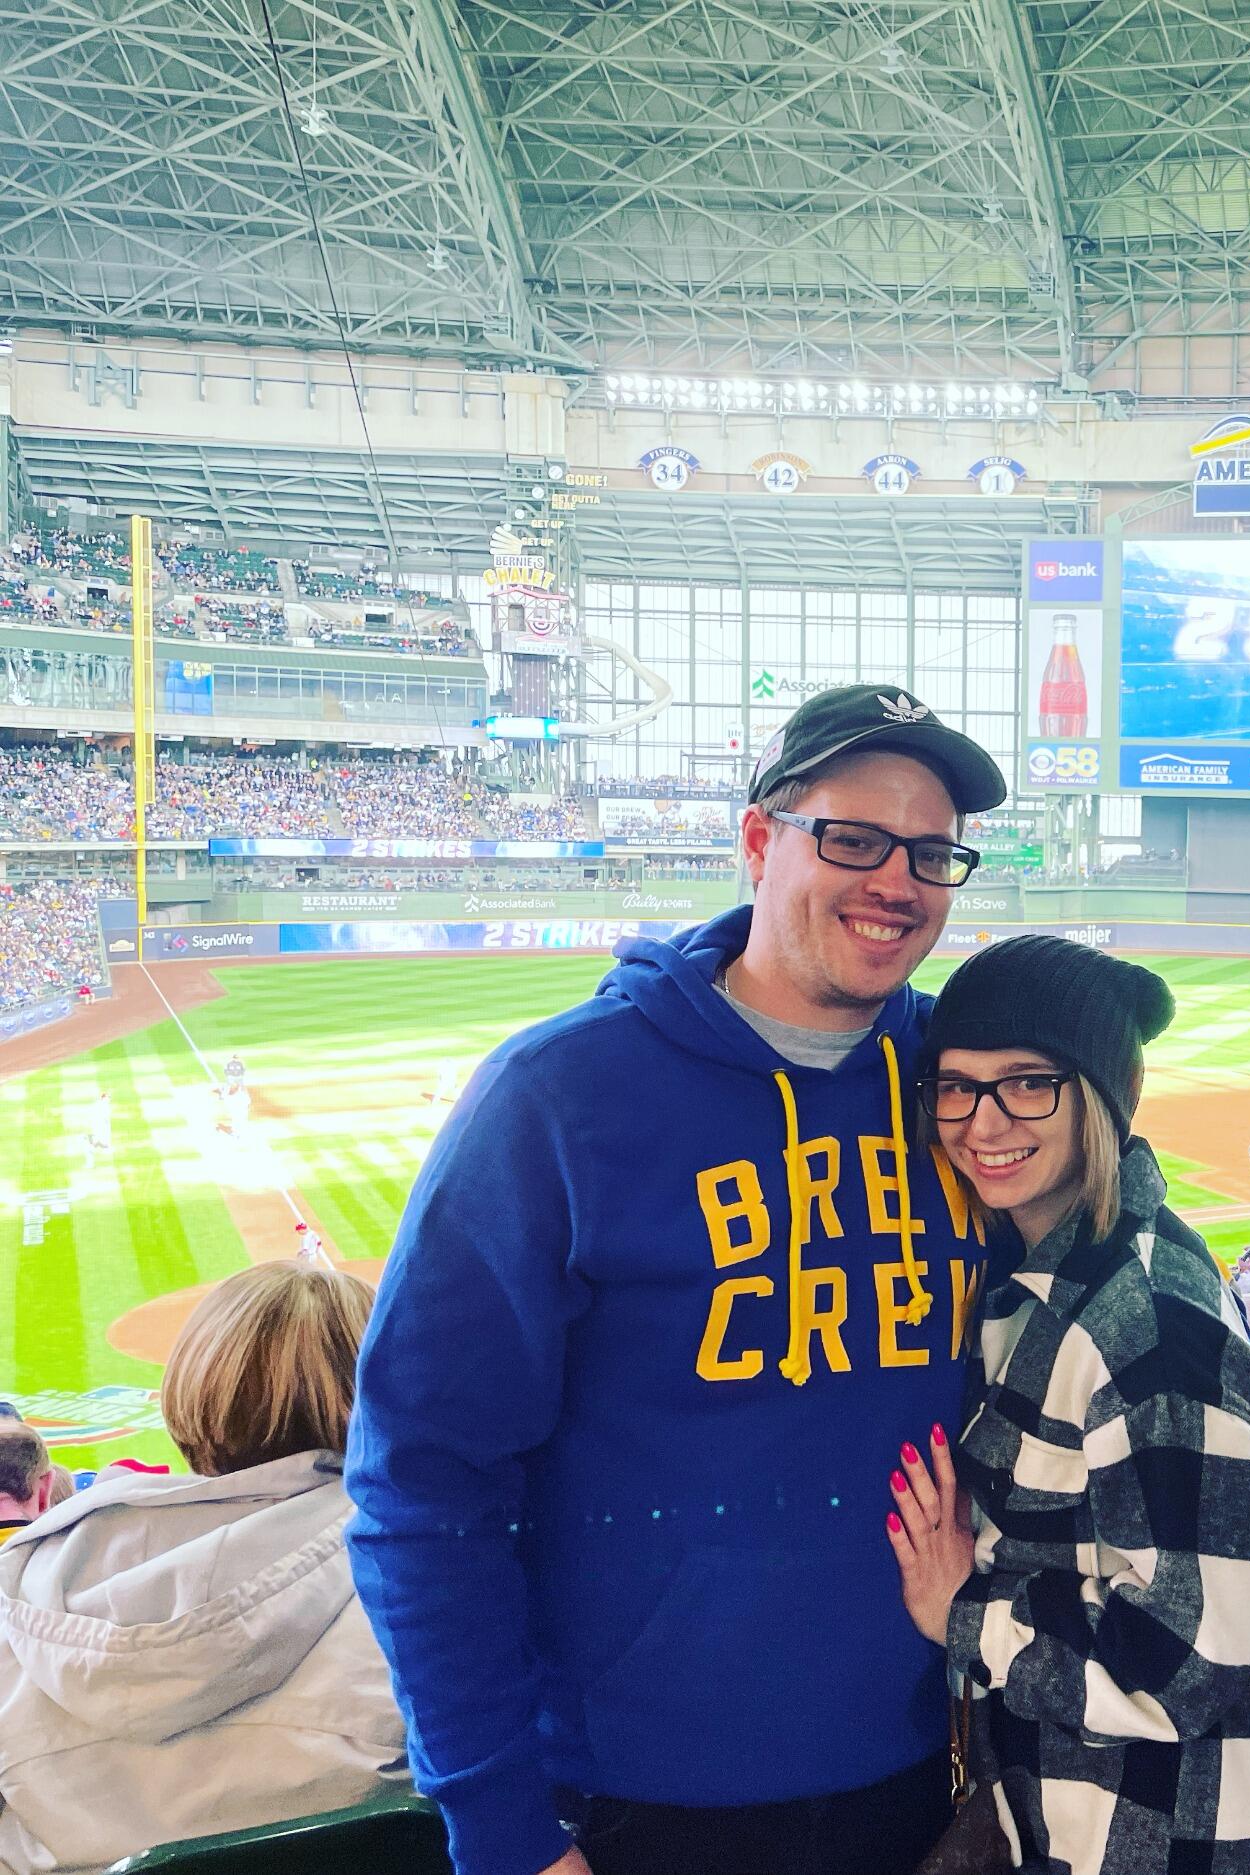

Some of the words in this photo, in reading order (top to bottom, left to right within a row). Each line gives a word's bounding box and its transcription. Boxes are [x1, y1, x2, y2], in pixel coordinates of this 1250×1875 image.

[649, 447, 691, 461] FINGERS
[876, 454, 908, 466] AARON
[983, 456, 1012, 467] SELIG
[565, 473, 608, 487] GONE!
[656, 463, 683, 482] 34
[767, 468, 794, 486] 42
[878, 471, 905, 489] 44
[992, 474, 1001, 491] 1
[1037, 565, 1055, 577] us
[1058, 562, 1098, 577] bank
[482, 567, 557, 591] CHALET
[1054, 747, 1100, 778] 58
[1141, 765, 1191, 775] AMERICAN
[1193, 766, 1229, 776] FAMILY
[1147, 775, 1223, 783] INSURANCE
[372, 839, 473, 858] STKES
[302, 895, 398, 906] RESTAURANT
[480, 897, 535, 909] Associated
[972, 897, 1008, 910] Save
[192, 933, 254, 949] SignalWire
[482, 923, 504, 948] 2
[948, 931, 977, 944] Fleet
[1065, 924, 1112, 948] meijer
